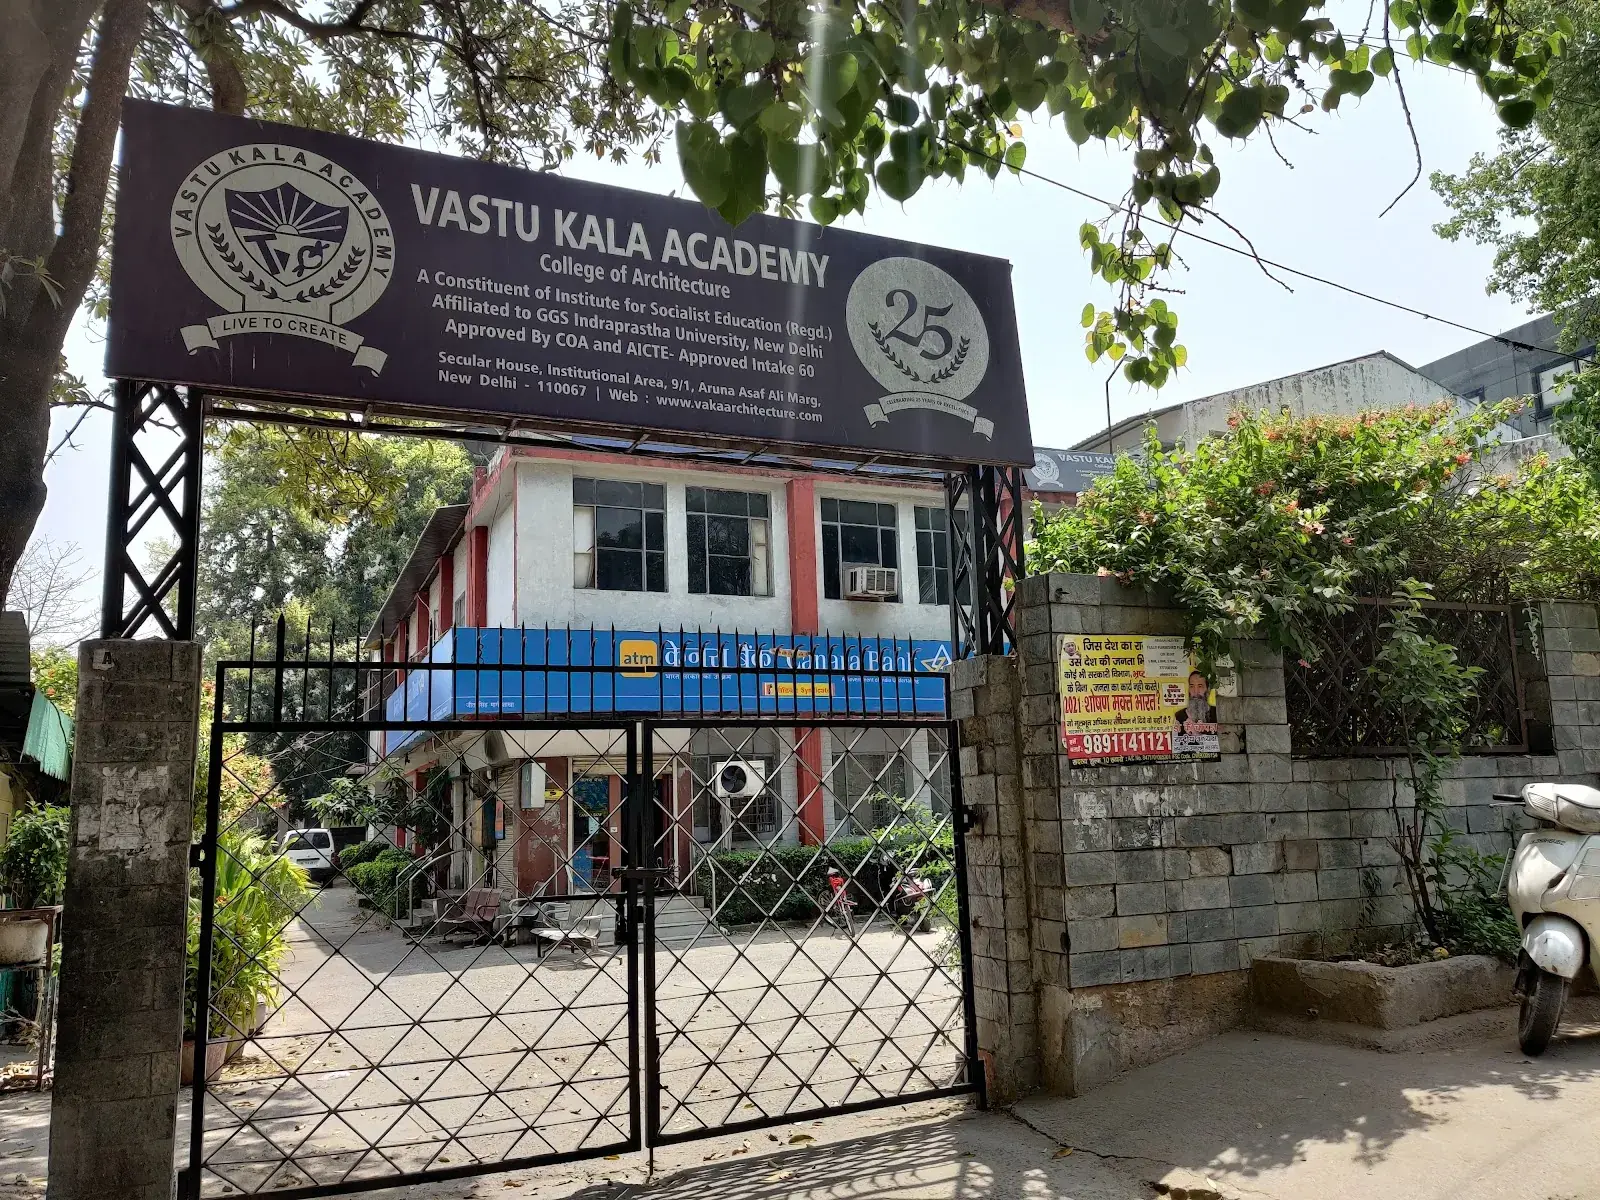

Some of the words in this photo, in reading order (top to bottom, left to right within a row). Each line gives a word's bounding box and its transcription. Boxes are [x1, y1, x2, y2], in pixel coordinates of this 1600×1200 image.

[174, 161, 222, 238] VASTU
[227, 146, 307, 166] KALA
[318, 163, 392, 279] ACADEMY
[410, 183, 540, 242] VASTU
[554, 208, 653, 261] KALA
[661, 228, 830, 288] ACADEMY
[539, 253, 605, 283] College
[610, 264, 628, 284] of
[632, 267, 731, 299] Architecture
[223, 317, 257, 331] LIVE
[263, 317, 283, 329] TO
[288, 319, 347, 345] CREATE
[416, 268, 430, 284] A
[434, 271, 530, 298] Constituent
[534, 286, 551, 301] of
[555, 288, 621, 311] Institute
[624, 298, 647, 314] for
[650, 301, 711, 324] Socialist
[714, 311, 783, 334] Education
[785, 320, 833, 342] (Regd.)
[431, 293, 510, 318] Affiliated
[514, 305, 532, 321] to
[536, 307, 569, 326] GGS
[574, 312, 671, 339] Indraprastha
[675, 326, 750, 352] University,
[753, 337, 785, 354] New
[788, 341, 824, 359] Delhi
[884, 288, 954, 361] 25
[444, 318, 526, 342] Approved
[531, 328, 551, 349] By
[555, 332, 589, 350] COA
[593, 339, 622, 354] and
[678, 348, 748, 370] Approved
[752, 357, 795, 376] Intake
[798, 363, 815, 378] 60
[438, 351, 492, 369] Secular
[495, 357, 543, 375] House,
[547, 363, 630, 385] Institutional
[633, 373, 668, 390] Area,
[671, 377, 695, 393] 9/1,
[698, 381, 735, 397] Aruna
[738, 386, 766, 401] Asaf
[768, 389, 784, 402] Ali
[787, 391, 822, 408] Marg,
[438, 369, 472, 385] New
[479, 374, 517, 390] Delhi
[537, 380, 587, 397] 110067
[608, 388, 638, 403] Web
[656, 395, 823, 423] www.vakaarchitecture.com
[1057, 453, 1093, 463] VASTU
[1095, 456, 1116, 465] KAL
[623, 651, 654, 666] atm
[1069, 657, 1081, 667] उस
[1084, 654, 1097, 667] देश
[1099, 654, 1110, 666] की
[1112, 656, 1135, 666] जनता
[1083, 637, 1102, 651] जिस
[1104, 638, 1118, 651] देश
[1120, 641, 1132, 651] का
[1134, 641, 1144, 651] रा
[1083, 732, 1172, 755] 9891141121
